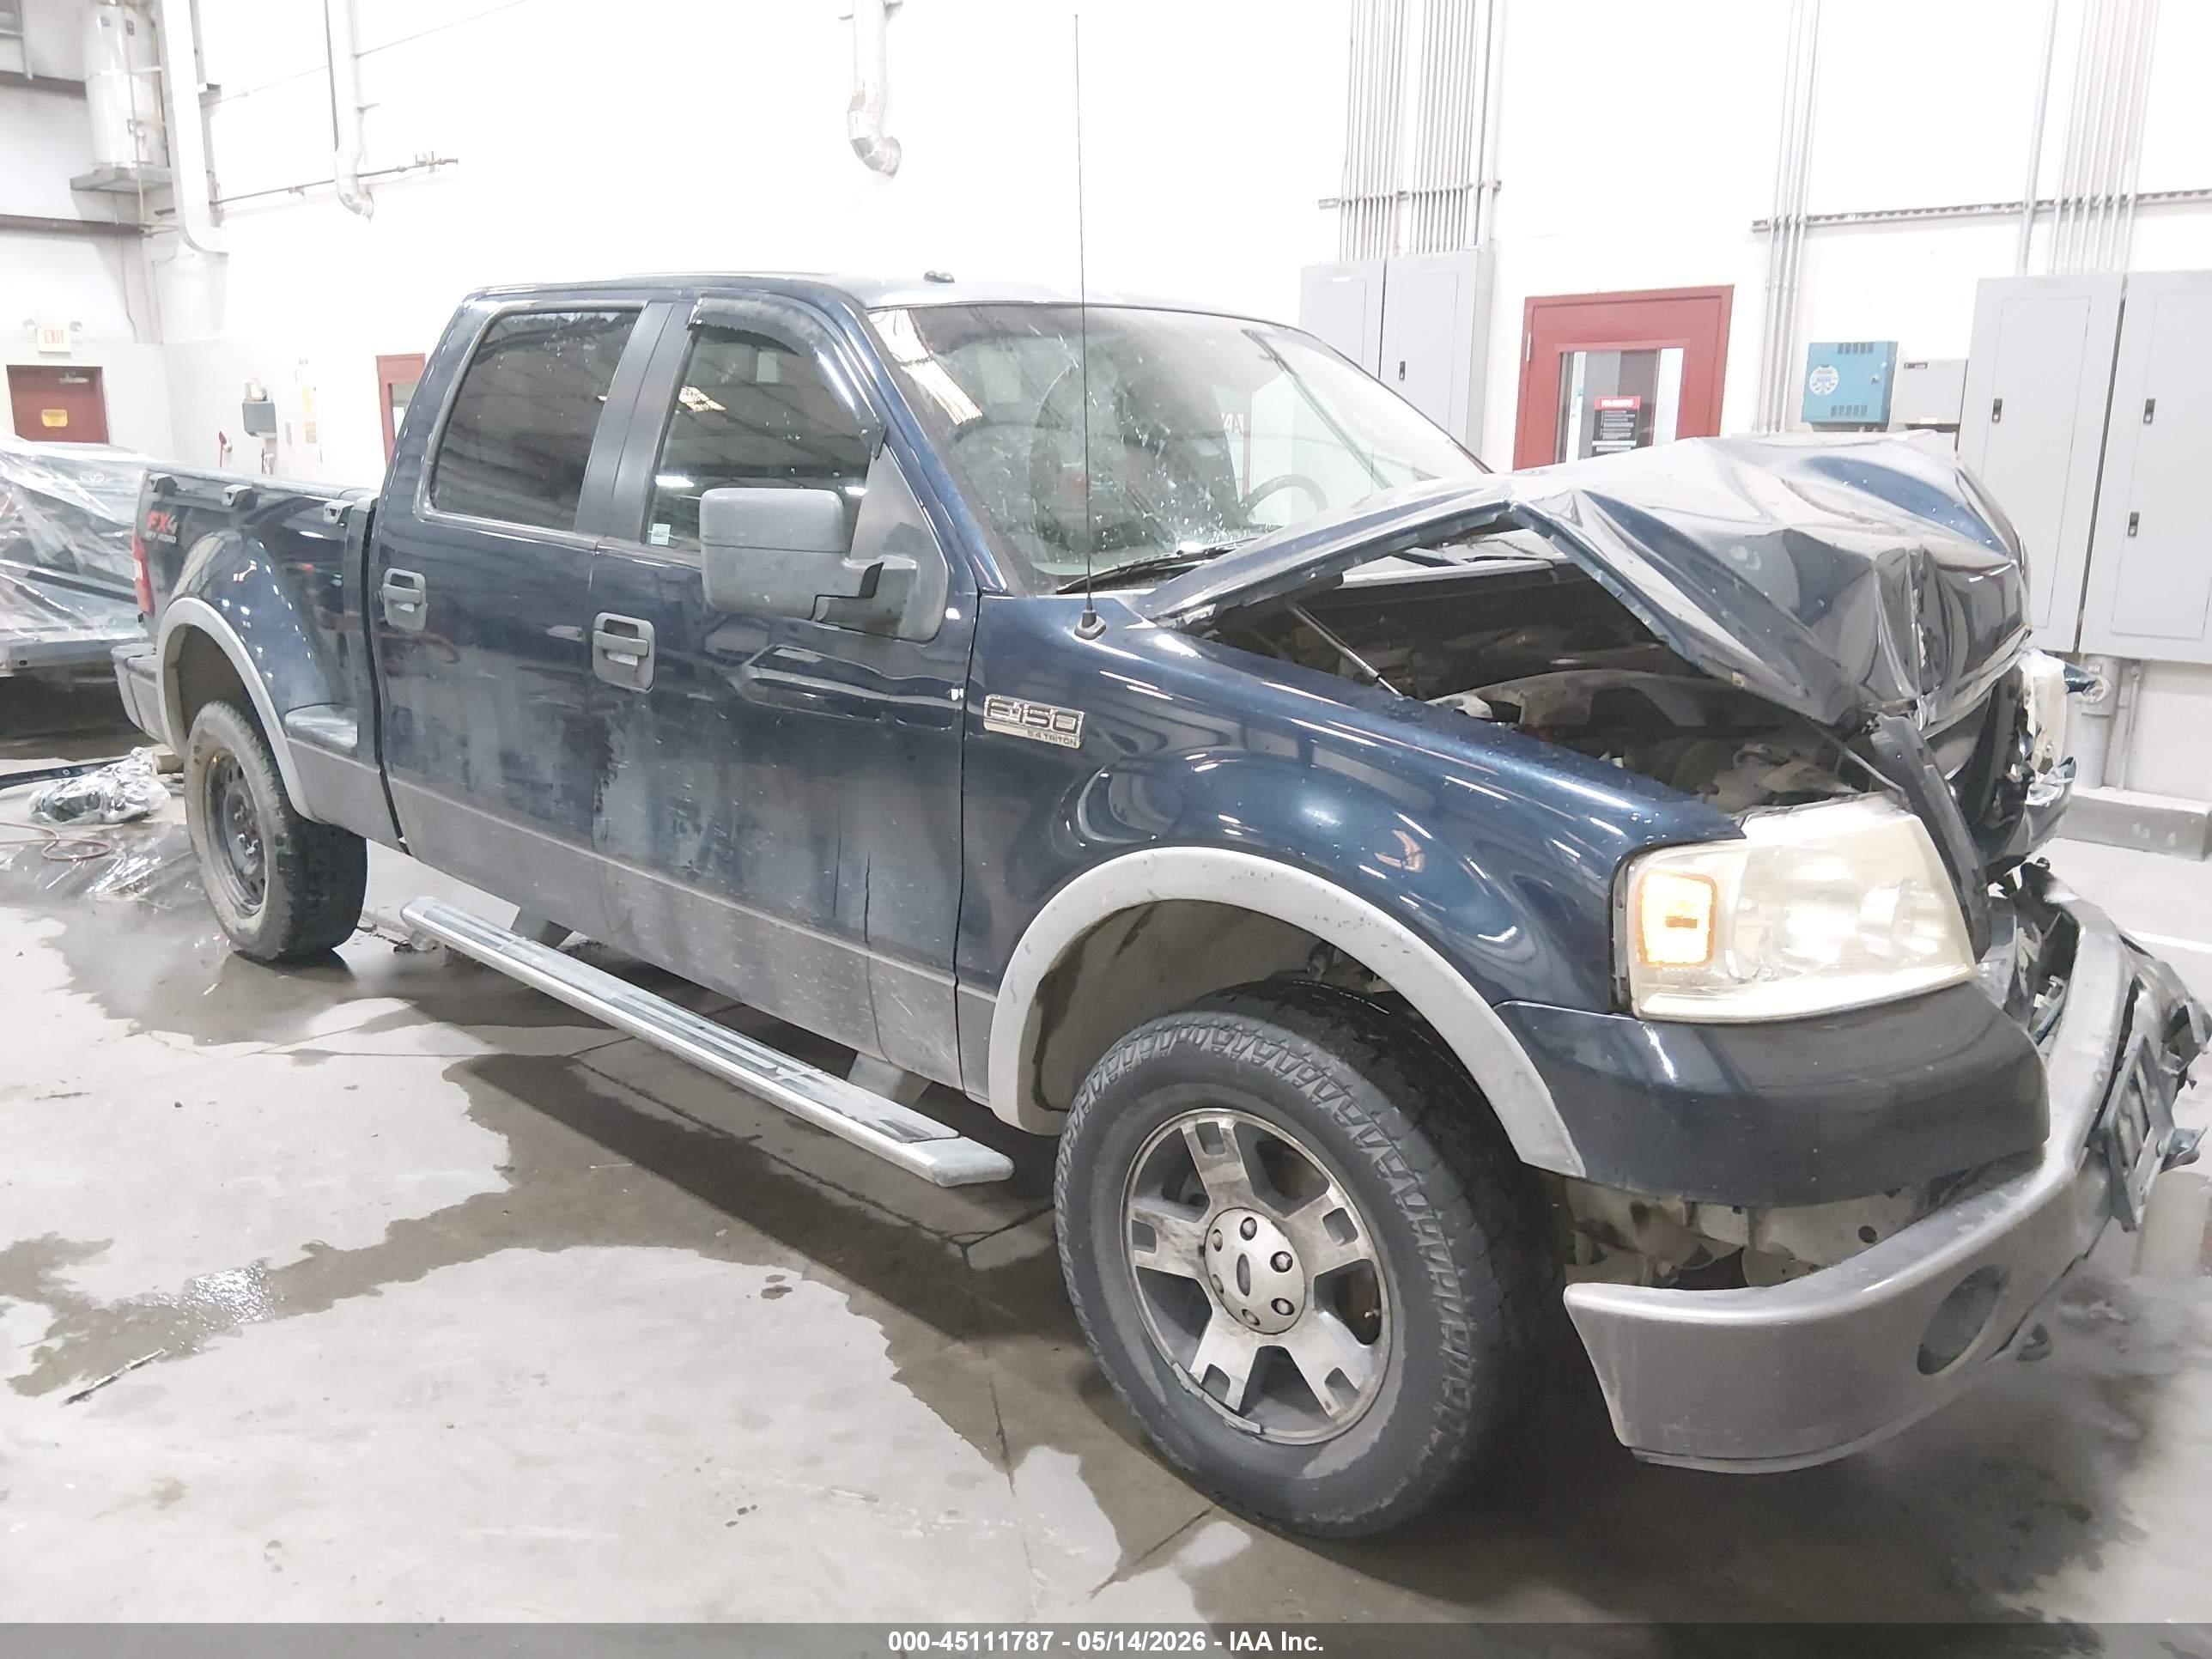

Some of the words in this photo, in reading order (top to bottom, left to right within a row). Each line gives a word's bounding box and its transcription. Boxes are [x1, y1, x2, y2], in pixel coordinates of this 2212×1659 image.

[44, 329, 64, 343] EXIT
[147, 512, 178, 534] FX4
[1043, 733, 1078, 747] TRITON
